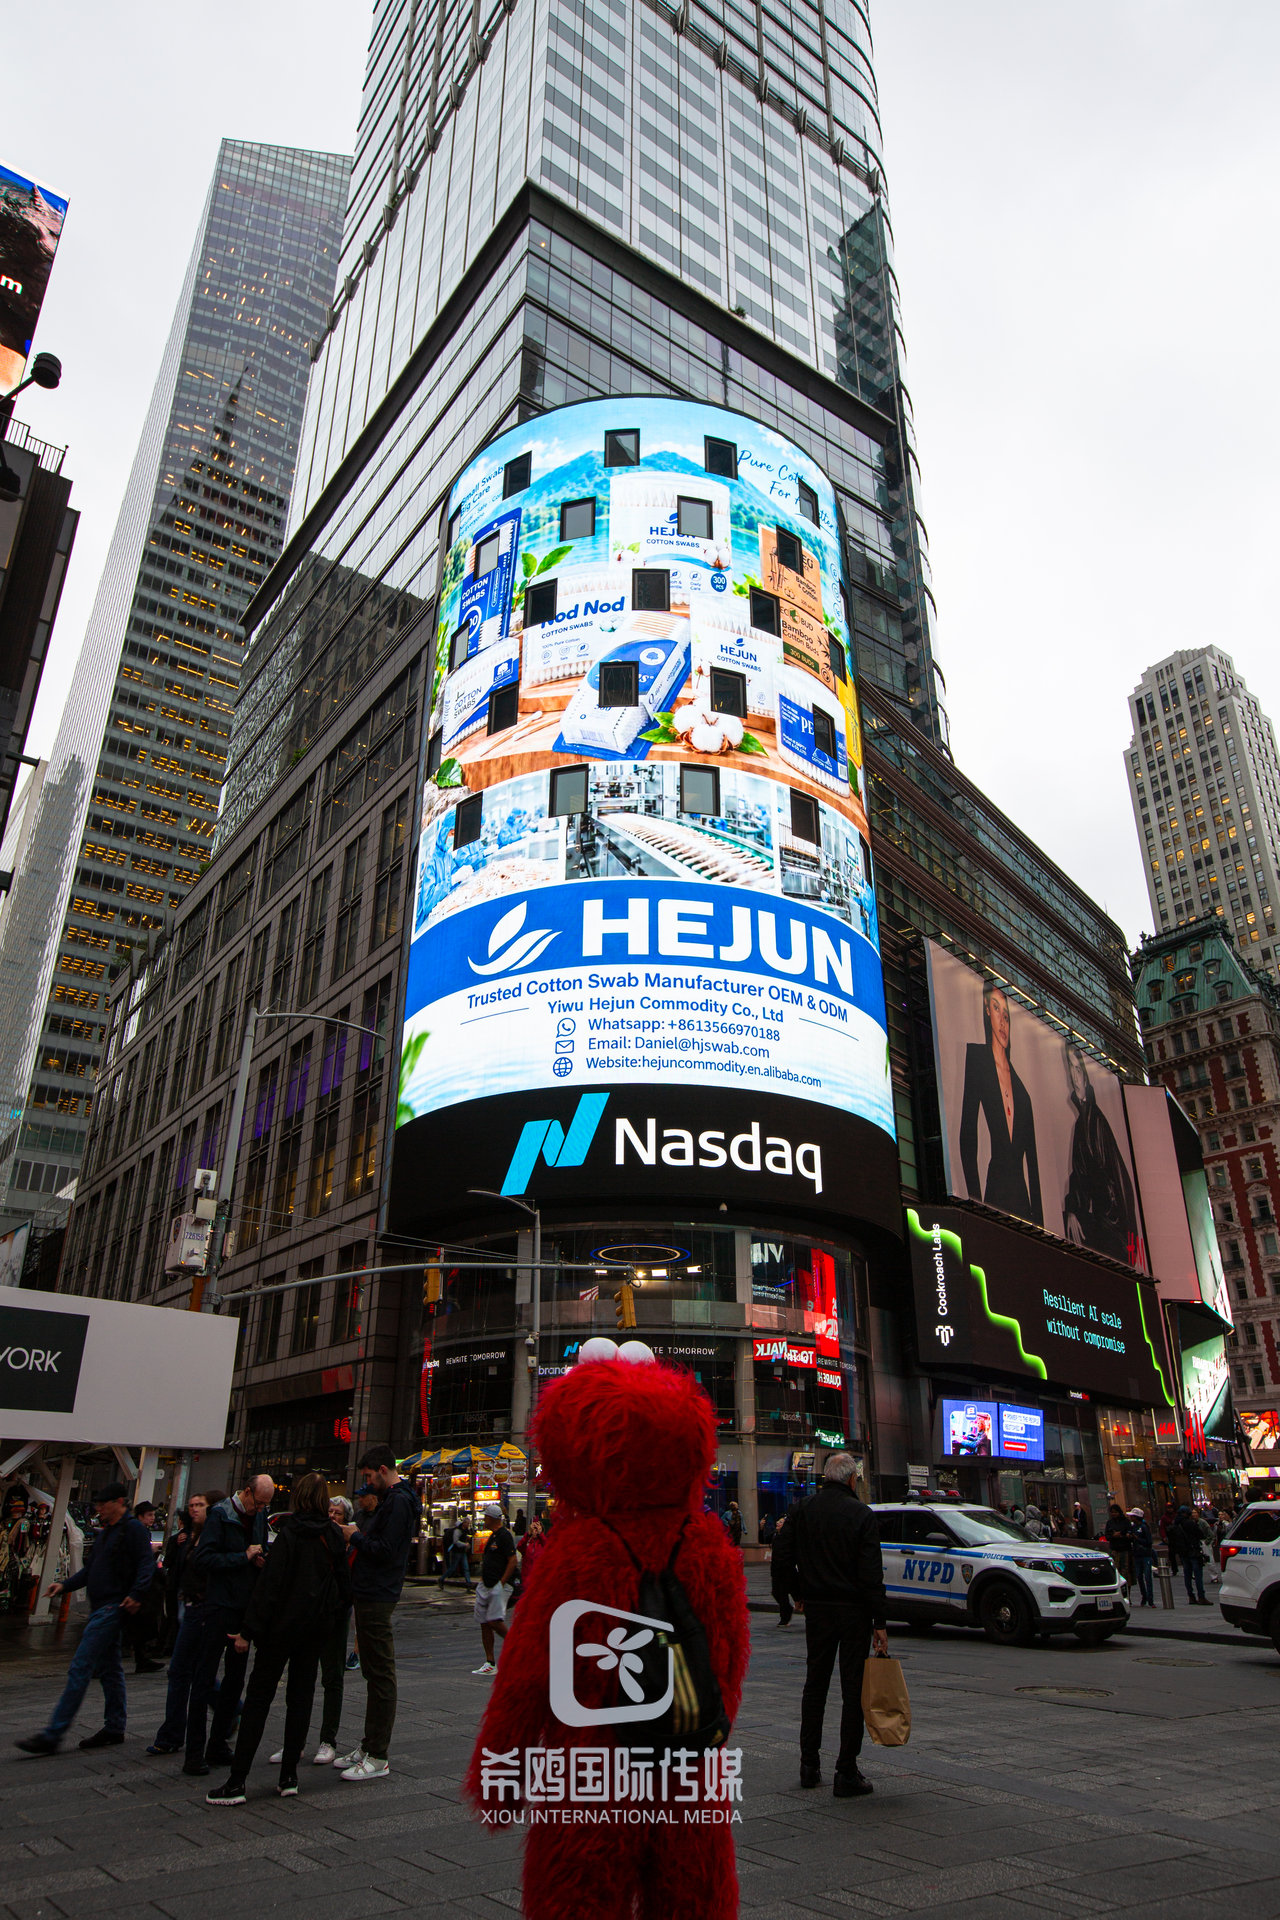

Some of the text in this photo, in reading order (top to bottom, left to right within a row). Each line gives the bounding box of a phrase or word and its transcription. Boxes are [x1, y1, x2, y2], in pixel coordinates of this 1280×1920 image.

[737, 449, 774, 472] Pure
[472, 485, 490, 503] Care
[769, 480, 791, 499] For
[675, 541, 700, 549] SWABS
[461, 577, 489, 600] COTTON
[712, 576, 726, 585] 300
[461, 588, 486, 610] SWABS
[583, 596, 625, 616] Nod
[541, 621, 593, 639] COTTON SWABS
[782, 620, 814, 644] Bamboo
[783, 629, 805, 646] Cotton
[717, 655, 762, 672] COTTON SWABS
[720, 644, 757, 662] HEJUN
[790, 648, 800, 659] 300
[454, 686, 482, 711] COTTON
[454, 698, 476, 719] SWABS
[582, 898, 856, 996] HEJUN
[468, 972, 848, 1023] Trusted Cotton Swab Manufacturer OEM & ODM
[548, 996, 784, 1023] Yiwu Hejun Commodity Co., Ltd
[588, 1018, 780, 1042] Whatsapp: +8613566970188
[588, 1036, 770, 1059] Email: Daniel@hjswab.com
[586, 1055, 822, 1088] Website:hejuncommodity.en.alibaba.com
[615, 1117, 823, 1194] Nasdaq
[932, 1223, 948, 1316] Cockroach Labs
[1043, 1289, 1122, 1330] Resilient AI scale
[1046, 1318, 1126, 1354] without compromise
[445, 1356, 468, 1365] REWRITE
[470, 1351, 506, 1362] TOMORROW
[667, 1346, 715, 1356] TOMORROW
[1157, 1422, 1175, 1436] H&M
[982, 1552, 1004, 1560] POLICE
[902, 1559, 954, 1584] NYPD
